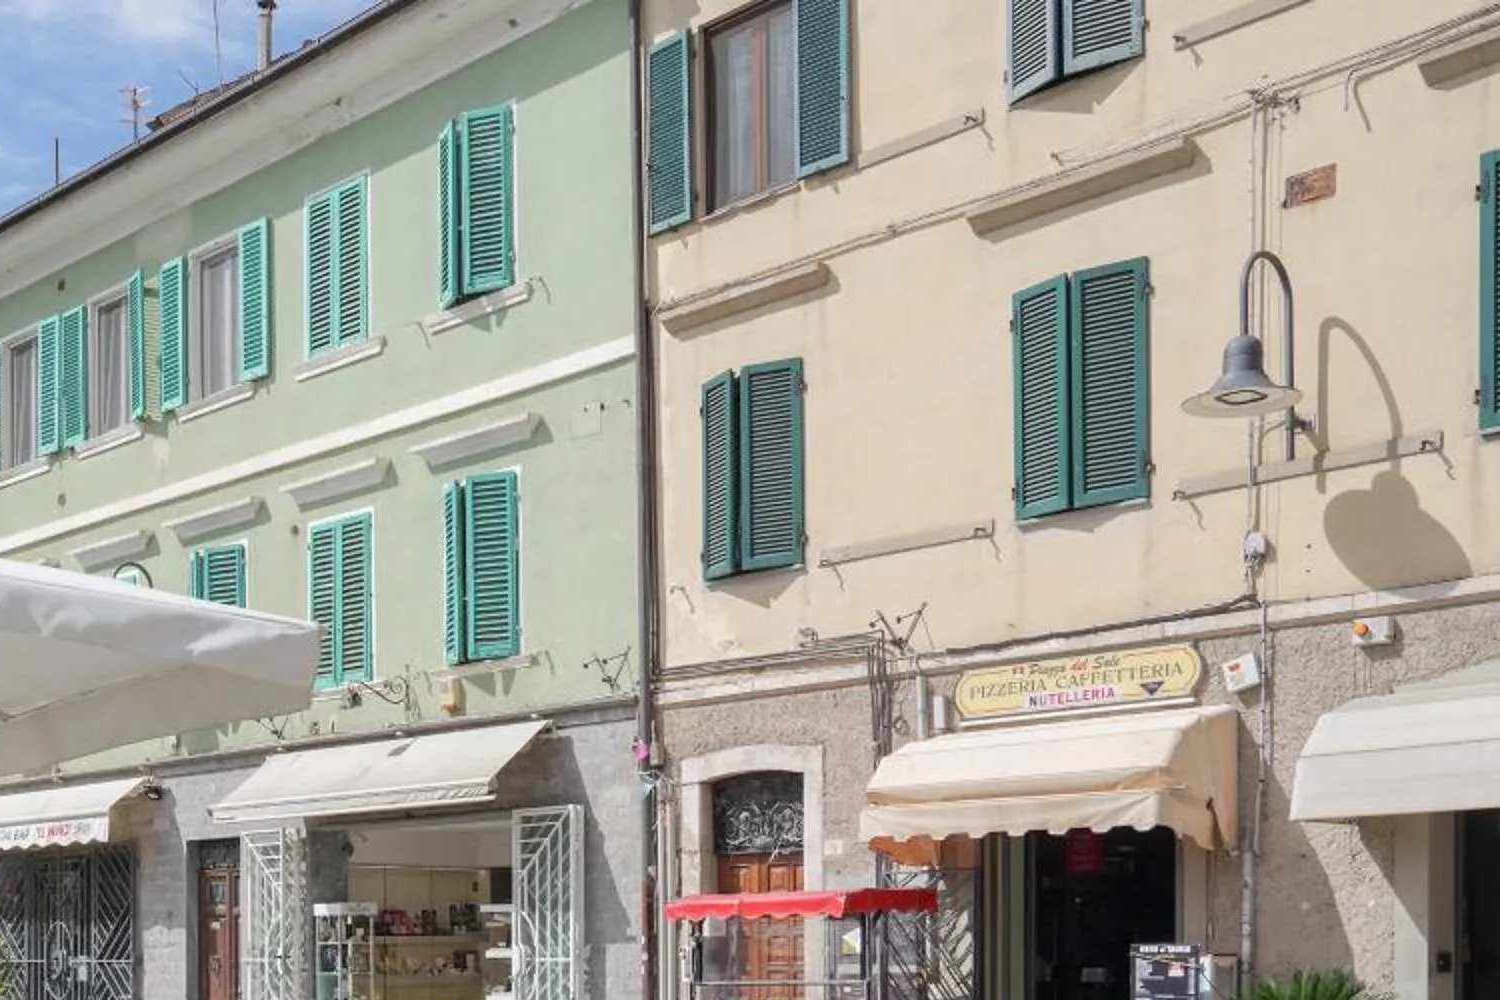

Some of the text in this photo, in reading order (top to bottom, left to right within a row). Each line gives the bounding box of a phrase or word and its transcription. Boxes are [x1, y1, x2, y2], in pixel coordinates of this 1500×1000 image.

[969, 661, 1183, 700] PIZZERIA CAFFETTERIA
[1029, 687, 1116, 708] NUTELLERIA
